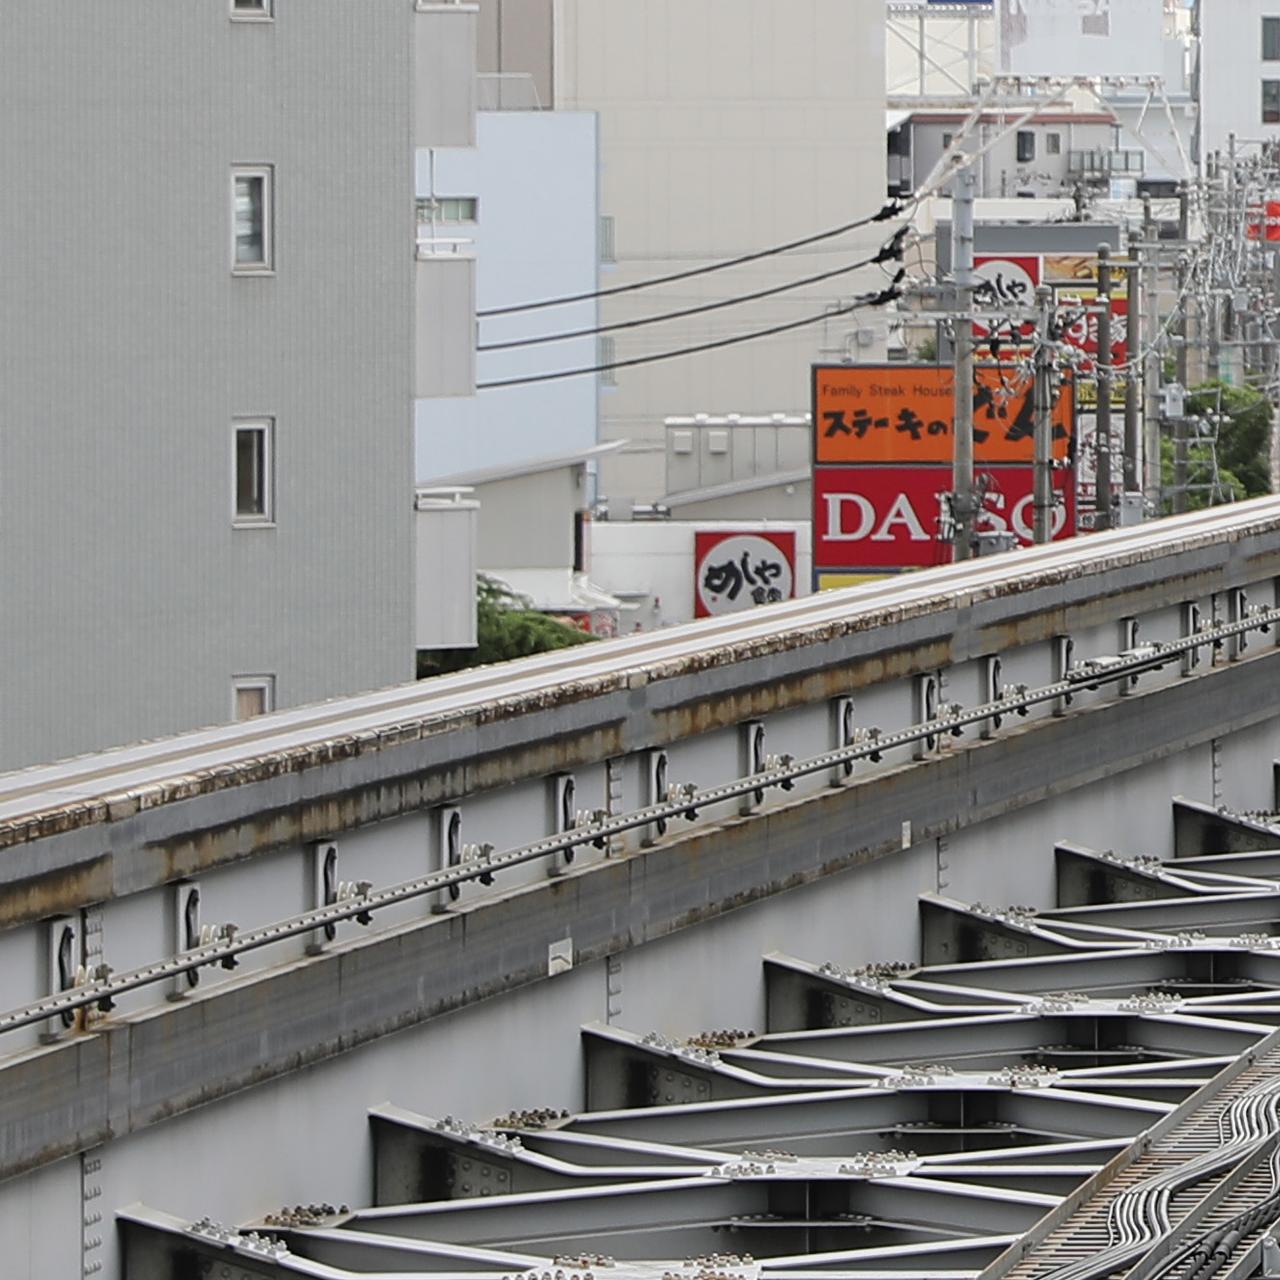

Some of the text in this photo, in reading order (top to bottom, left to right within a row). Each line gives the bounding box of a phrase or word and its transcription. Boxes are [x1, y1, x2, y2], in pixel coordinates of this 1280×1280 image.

[823, 384, 953, 398] Family Steak House
[704, 551, 782, 601] めしや
